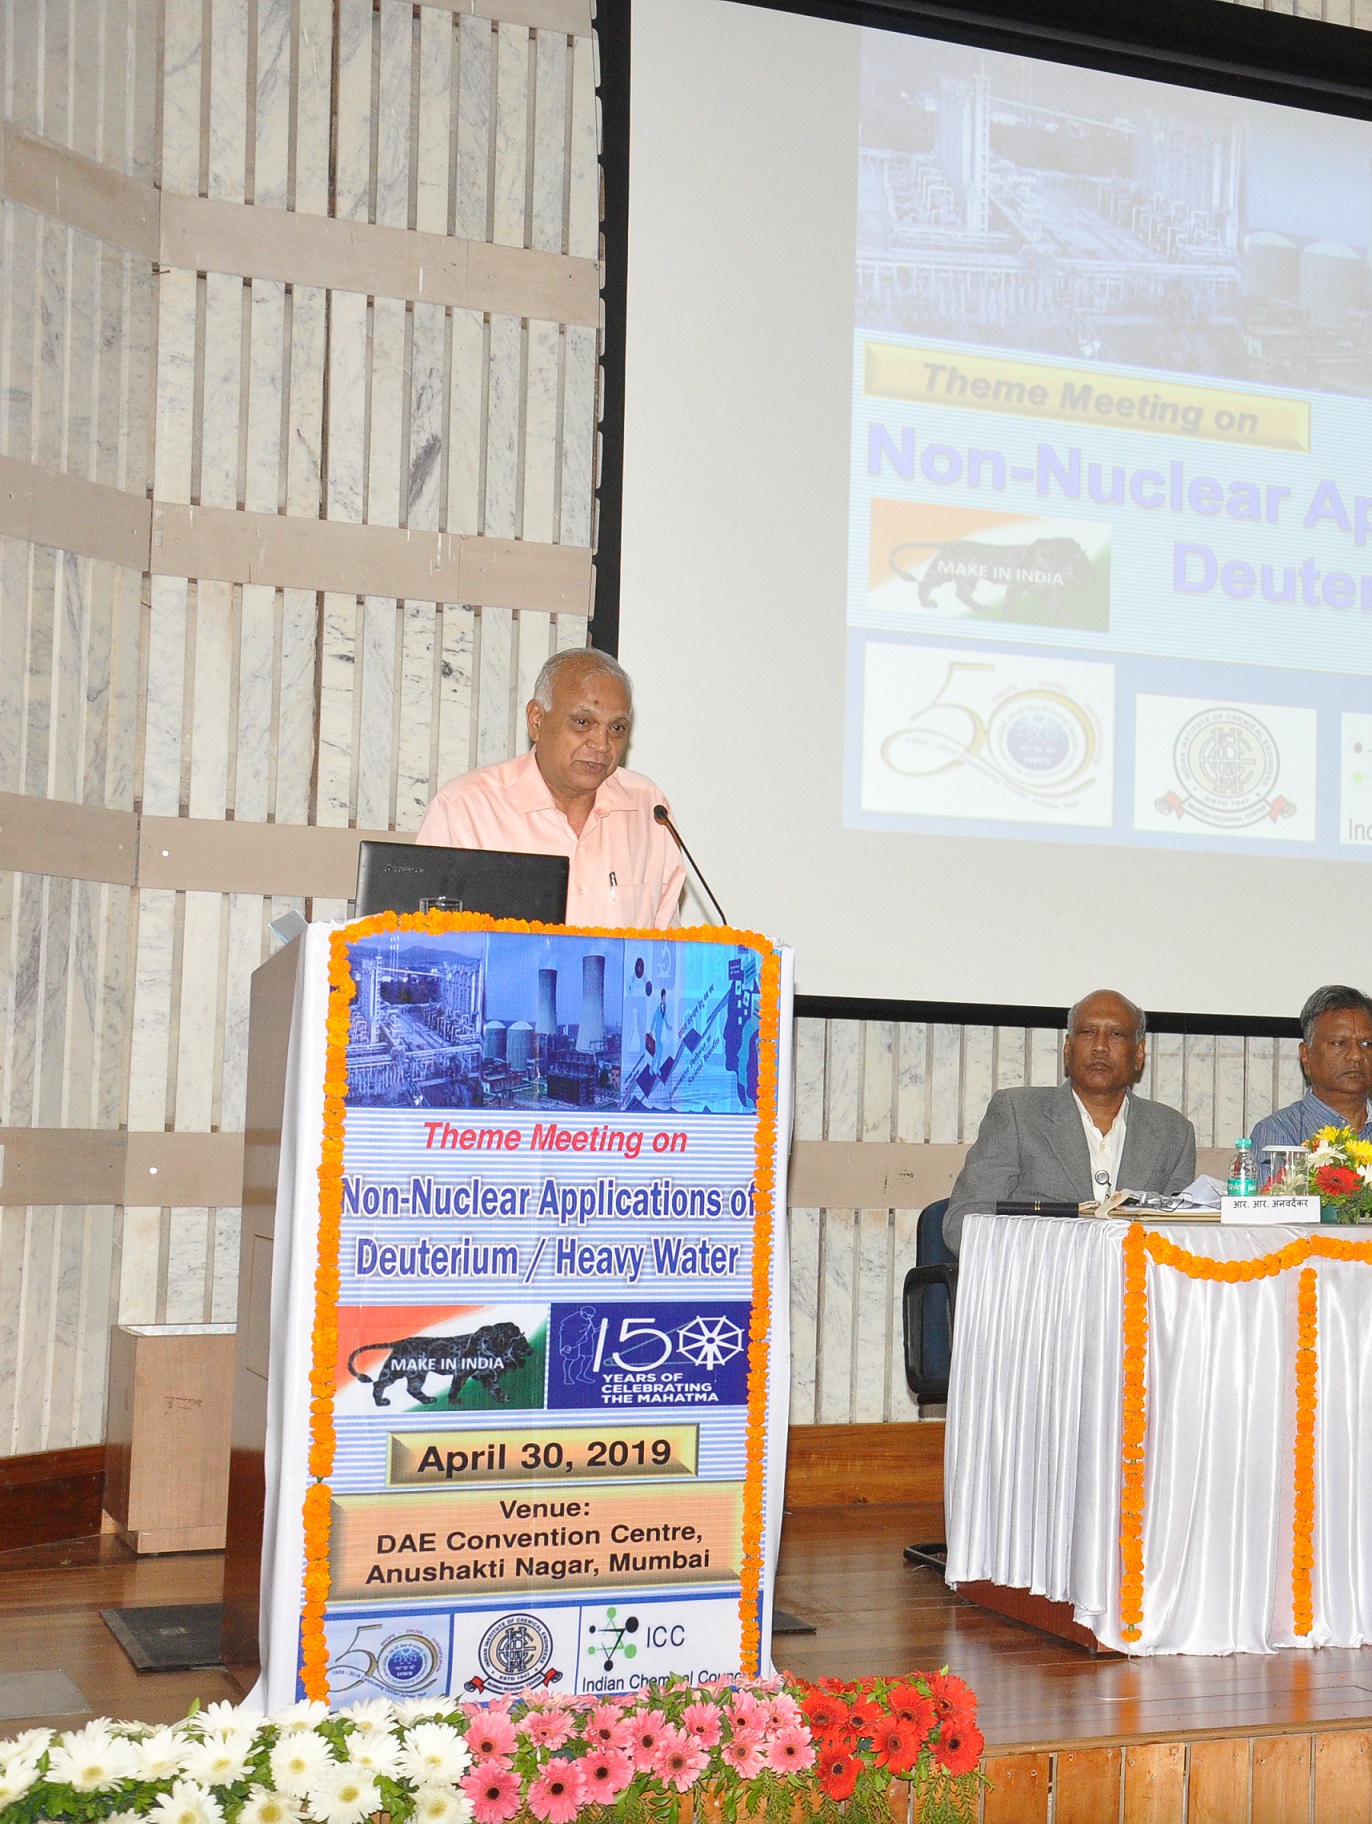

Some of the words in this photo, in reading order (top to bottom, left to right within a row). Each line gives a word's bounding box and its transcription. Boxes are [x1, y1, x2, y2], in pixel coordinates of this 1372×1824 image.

[922, 361, 1049, 406] Theme
[1059, 382, 1204, 433] Meeting
[1214, 408, 1259, 435] on
[868, 422, 1291, 523] Non-Nuclear
[937, 560, 988, 579] MAKE
[993, 566, 1012, 581] IN
[1015, 567, 1064, 586] INDIA
[1226, 714, 1264, 741] CHEMICAL
[423, 1121, 521, 1151] Theme
[530, 1124, 644, 1160] Meeting
[652, 1131, 688, 1153] on
[340, 1176, 531, 1216] Non-Nuclear
[537, 1178, 722, 1224] Applications
[356, 1236, 519, 1276] Deuterium
[524, 1237, 547, 1284] /
[555, 1237, 645, 1284] Heavy
[652, 1237, 740, 1275] Water
[390, 1357, 437, 1371] MAKE
[440, 1357, 457, 1371] IN
[460, 1356, 505, 1371] INDIA
[601, 1382, 712, 1394] CELEBRATING
[602, 1373, 657, 1383] YEARS
[661, 1372, 683, 1382] OF
[601, 1394, 633, 1404] THE
[637, 1393, 719, 1403] MAHATMA
[417, 1443, 507, 1479] April
[520, 1442, 574, 1473] 30,
[586, 1439, 672, 1468] 2019
[499, 1499, 591, 1519] Venue:
[377, 1533, 437, 1555] DAE
[446, 1526, 601, 1552] Convention
[610, 1522, 703, 1547] Centre,
[365, 1558, 505, 1585] Anushakti
[515, 1555, 600, 1582] Nagar,
[608, 1550, 710, 1572] Mumbai
[516, 1617, 542, 1632] CHEMICAL
[647, 1625, 685, 1648] ICC
[582, 1676, 625, 1692] Indian
